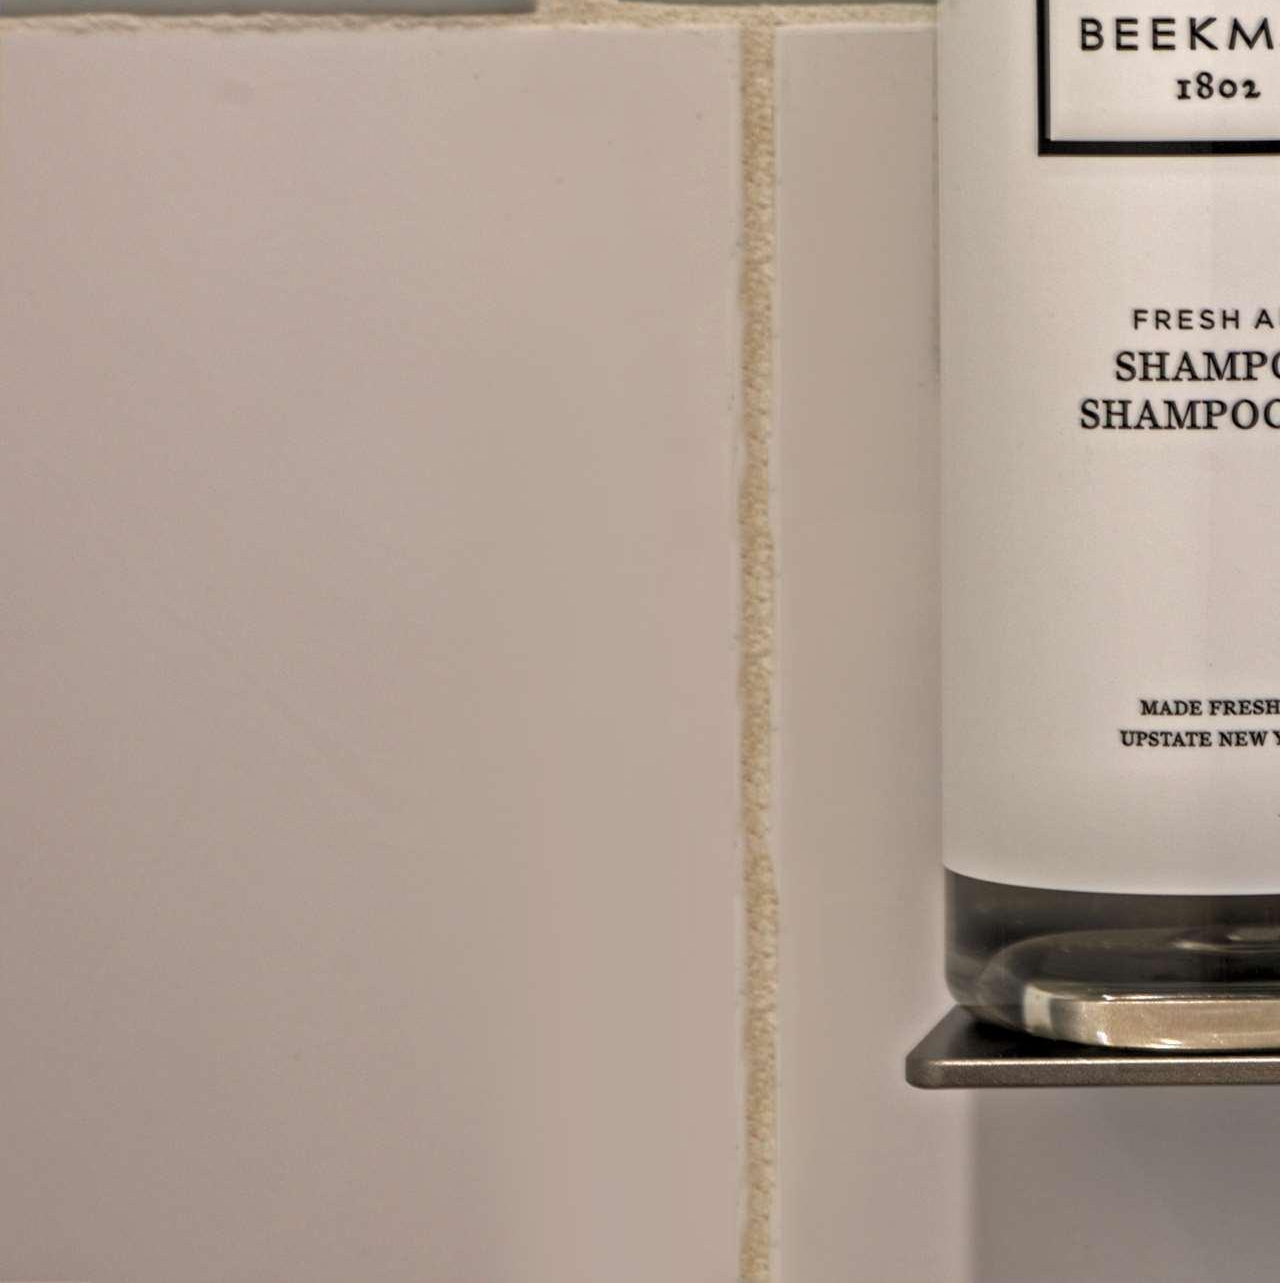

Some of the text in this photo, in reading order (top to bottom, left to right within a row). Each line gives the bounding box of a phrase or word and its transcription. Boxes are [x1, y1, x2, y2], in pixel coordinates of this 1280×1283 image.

[1176, 70, 1262, 101] 1802
[1132, 308, 1240, 331] FRESH
[1139, 699, 1203, 717] MADE
[1119, 729, 1213, 748] UPSTATE
[1217, 730, 1269, 748] NEW
